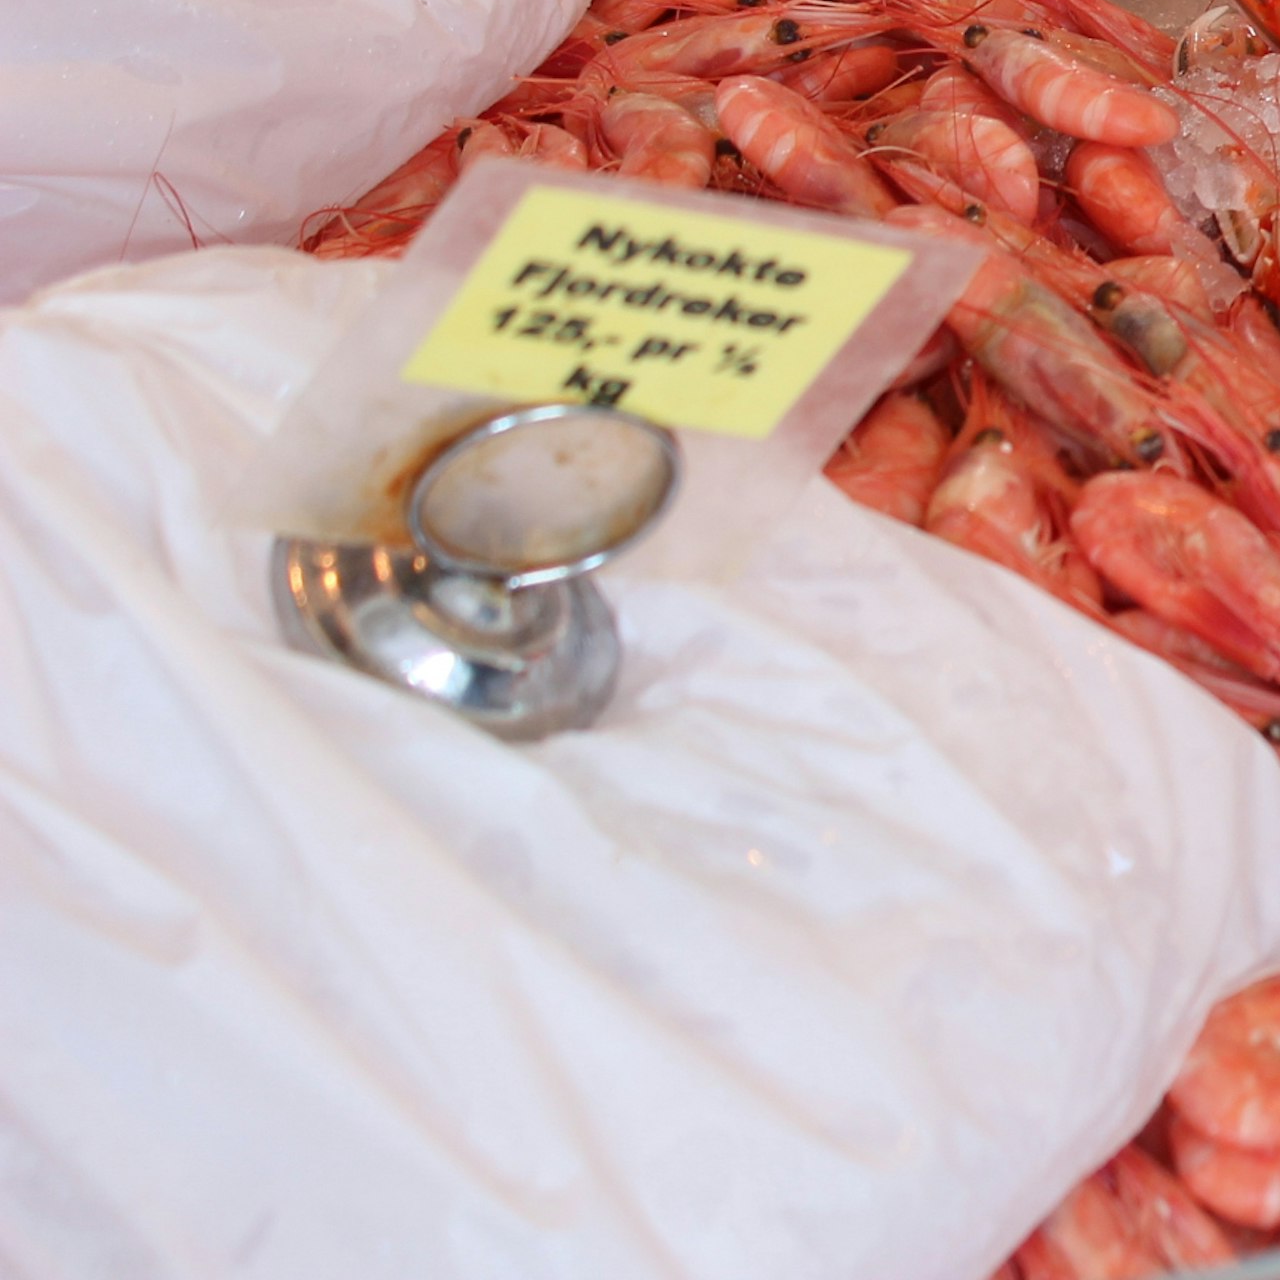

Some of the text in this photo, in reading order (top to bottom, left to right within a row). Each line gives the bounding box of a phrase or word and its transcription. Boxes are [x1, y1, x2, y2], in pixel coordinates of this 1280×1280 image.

[578, 225, 807, 287] Nykokte
[494, 306, 620, 353] 125,-
[630, 336, 700, 364] pr
[563, 366, 631, 407] kg
